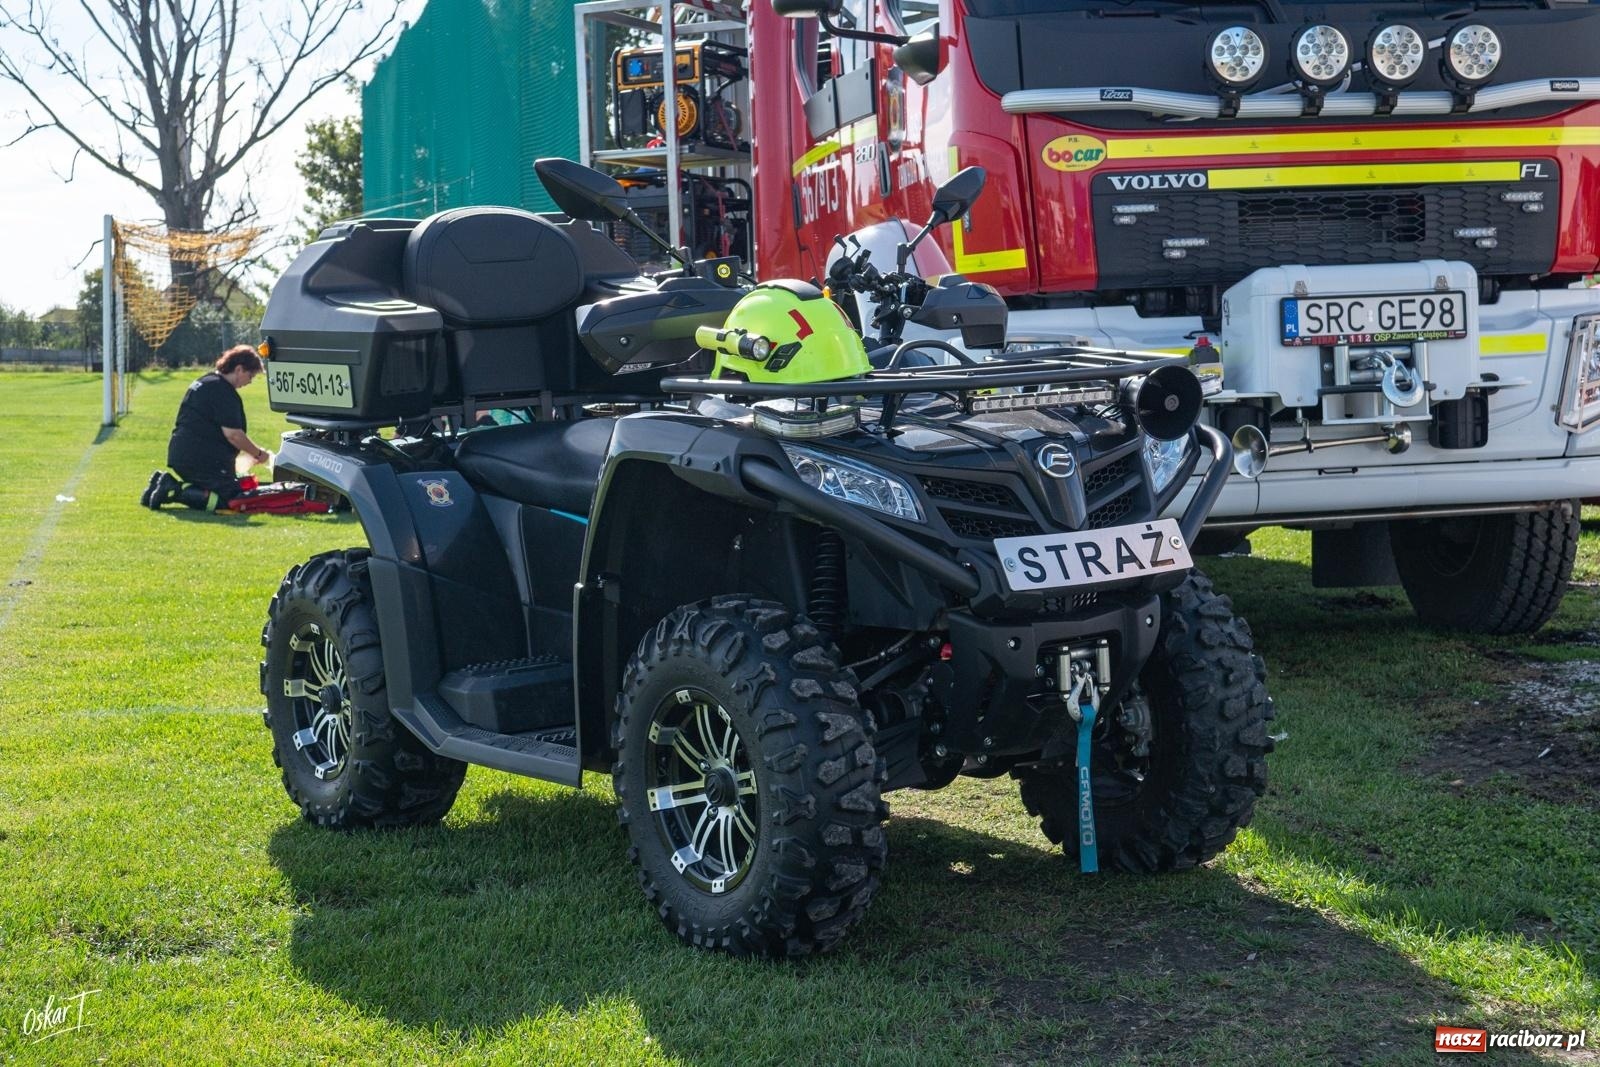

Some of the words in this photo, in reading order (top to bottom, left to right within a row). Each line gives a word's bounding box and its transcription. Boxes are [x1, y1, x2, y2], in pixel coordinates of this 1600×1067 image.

[855, 143, 876, 164] 280
[1047, 147, 1104, 163] bocar
[1520, 163, 1549, 178] FL
[1107, 172, 1207, 191] VOLVO
[1306, 301, 1365, 334] SRC
[1378, 298, 1455, 331] GE98
[1286, 324, 1297, 333] PL
[1373, 333, 1391, 343] OSP
[1391, 331, 1418, 340] Zawada
[307, 451, 343, 473] CFMOTO
[1017, 524, 1176, 584] STRAŻ
[1080, 766, 1094, 846] CFMOTO
